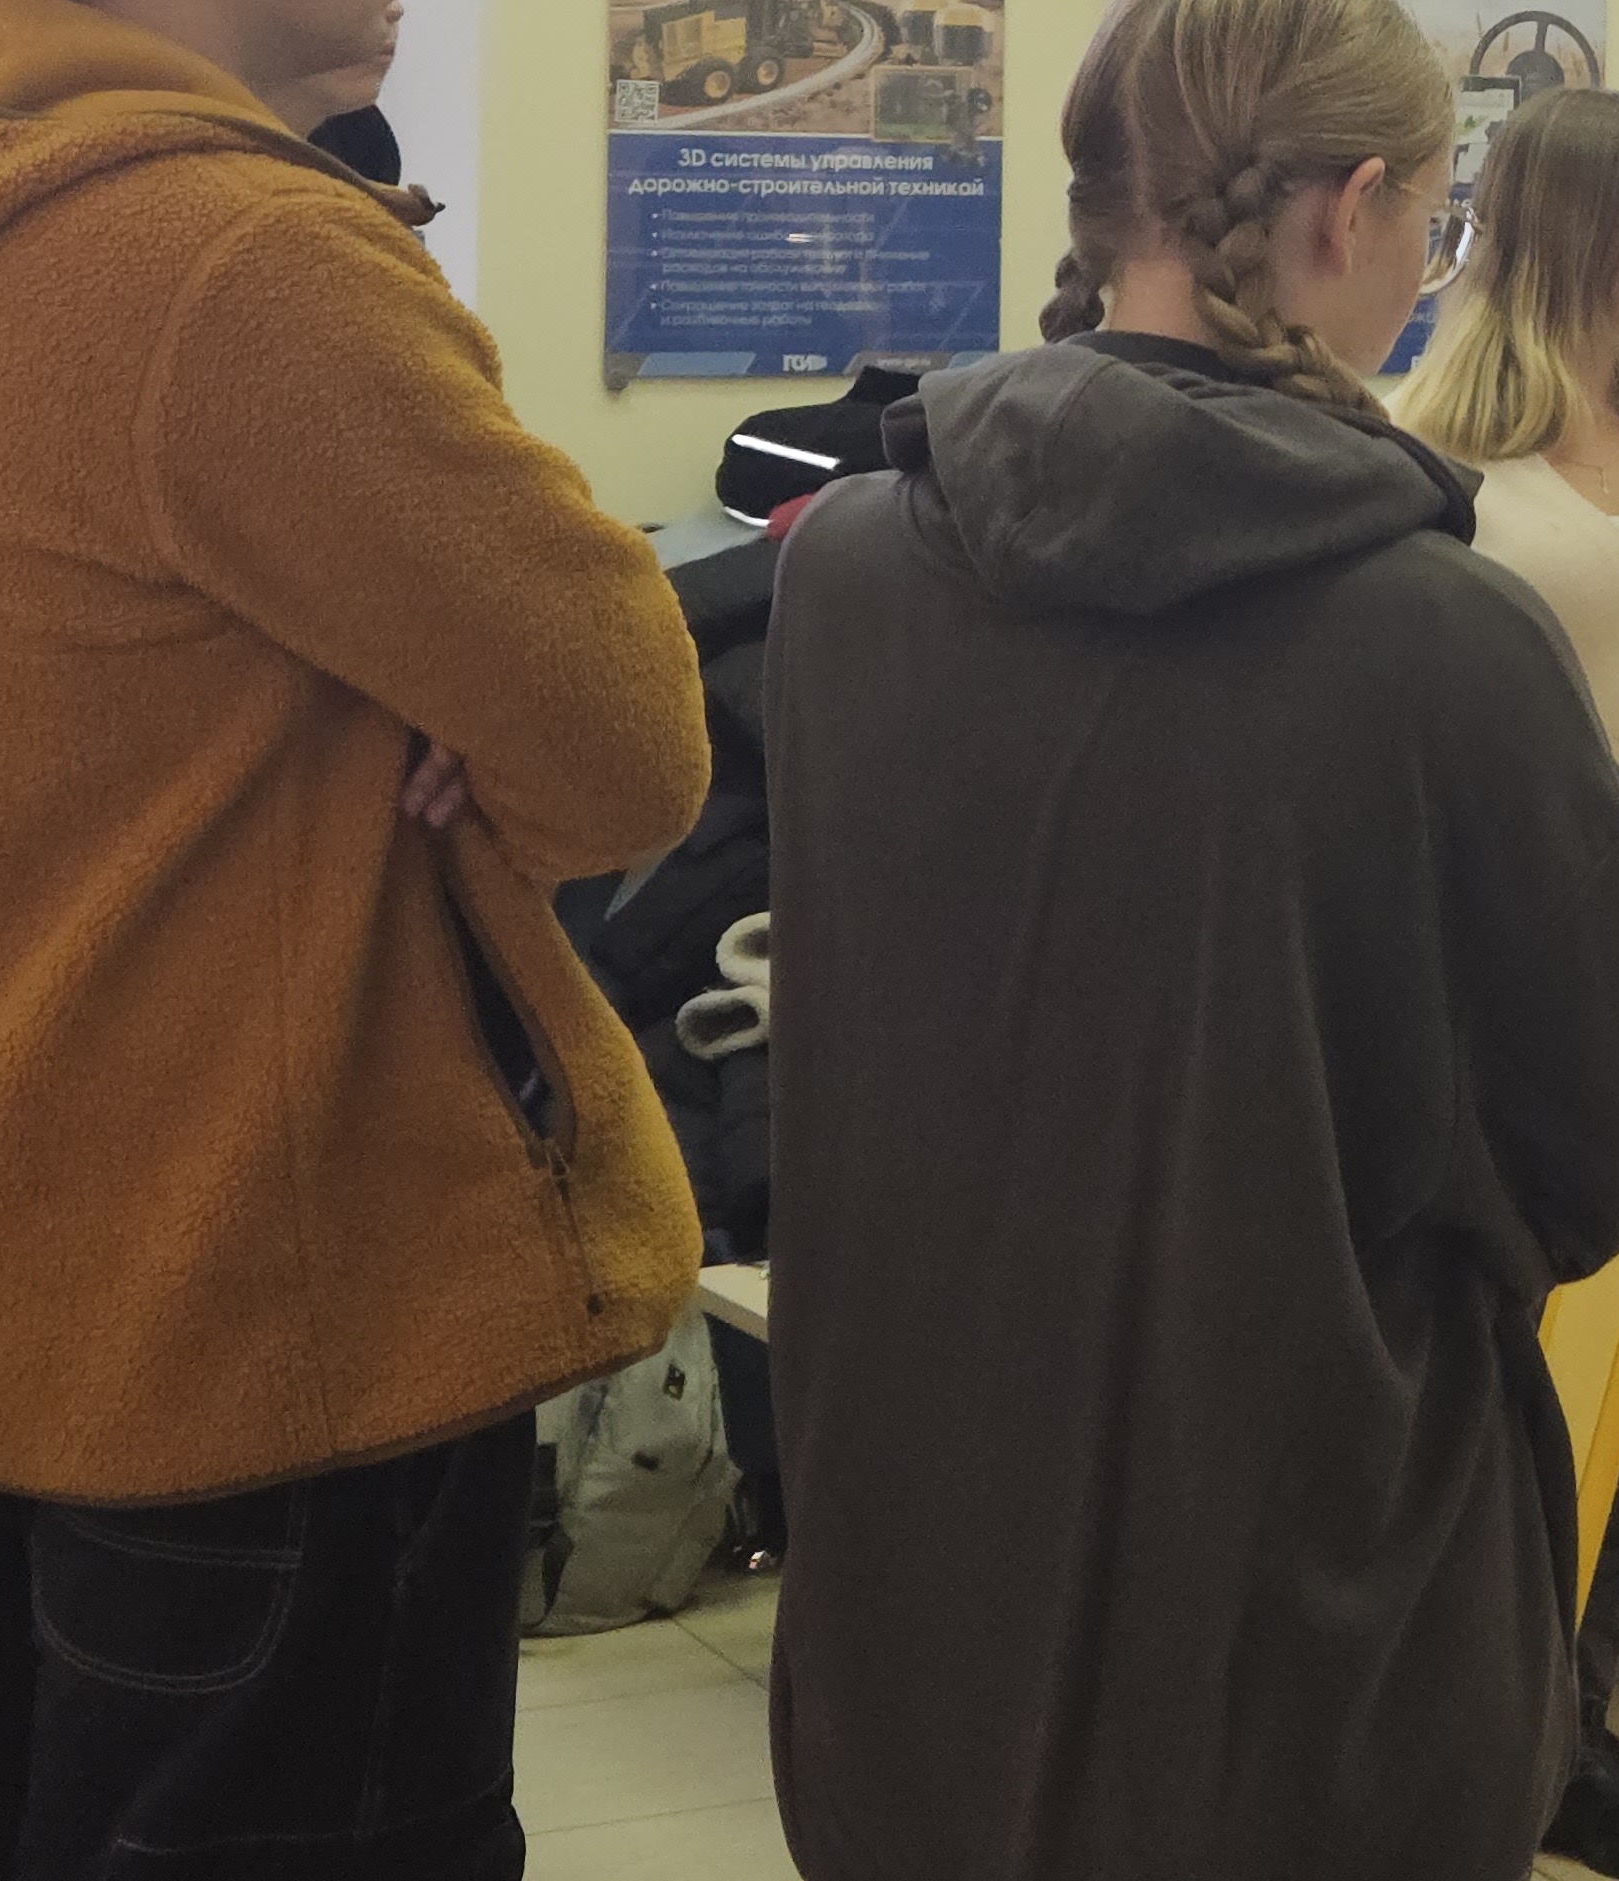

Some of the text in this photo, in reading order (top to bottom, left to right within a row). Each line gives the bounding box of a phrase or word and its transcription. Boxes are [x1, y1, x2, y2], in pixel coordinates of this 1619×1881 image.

[678, 147, 934, 172] 3D системы управления
[628, 176, 985, 198] дорожно-строительной техникой
